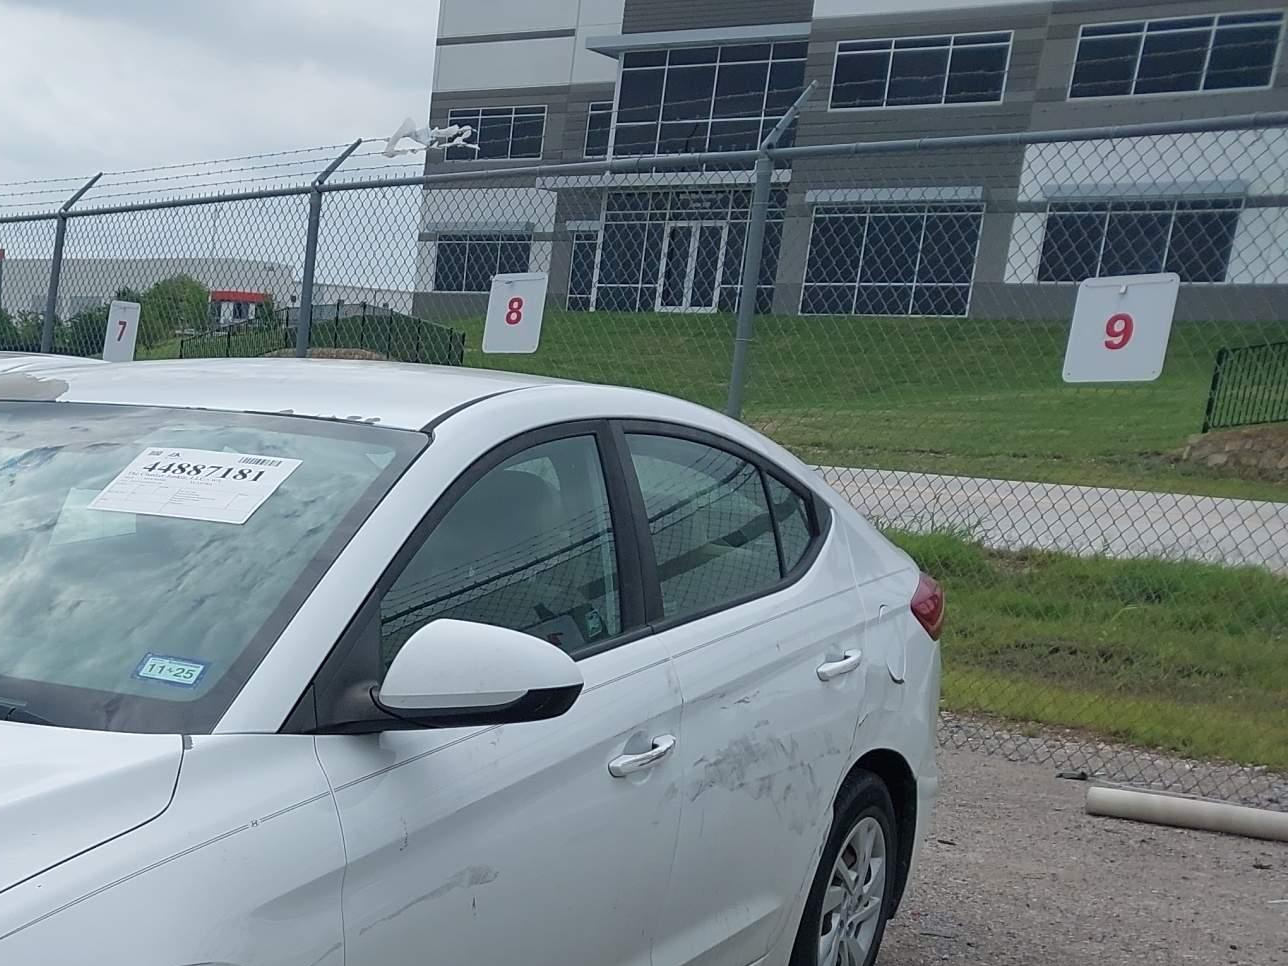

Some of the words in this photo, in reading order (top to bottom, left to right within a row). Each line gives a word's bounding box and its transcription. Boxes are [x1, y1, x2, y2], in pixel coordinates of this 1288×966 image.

[505, 297, 523, 325] 8
[117, 321, 127, 342] 7
[1104, 313, 1134, 350] 9
[143, 460, 265, 482] 44887181
